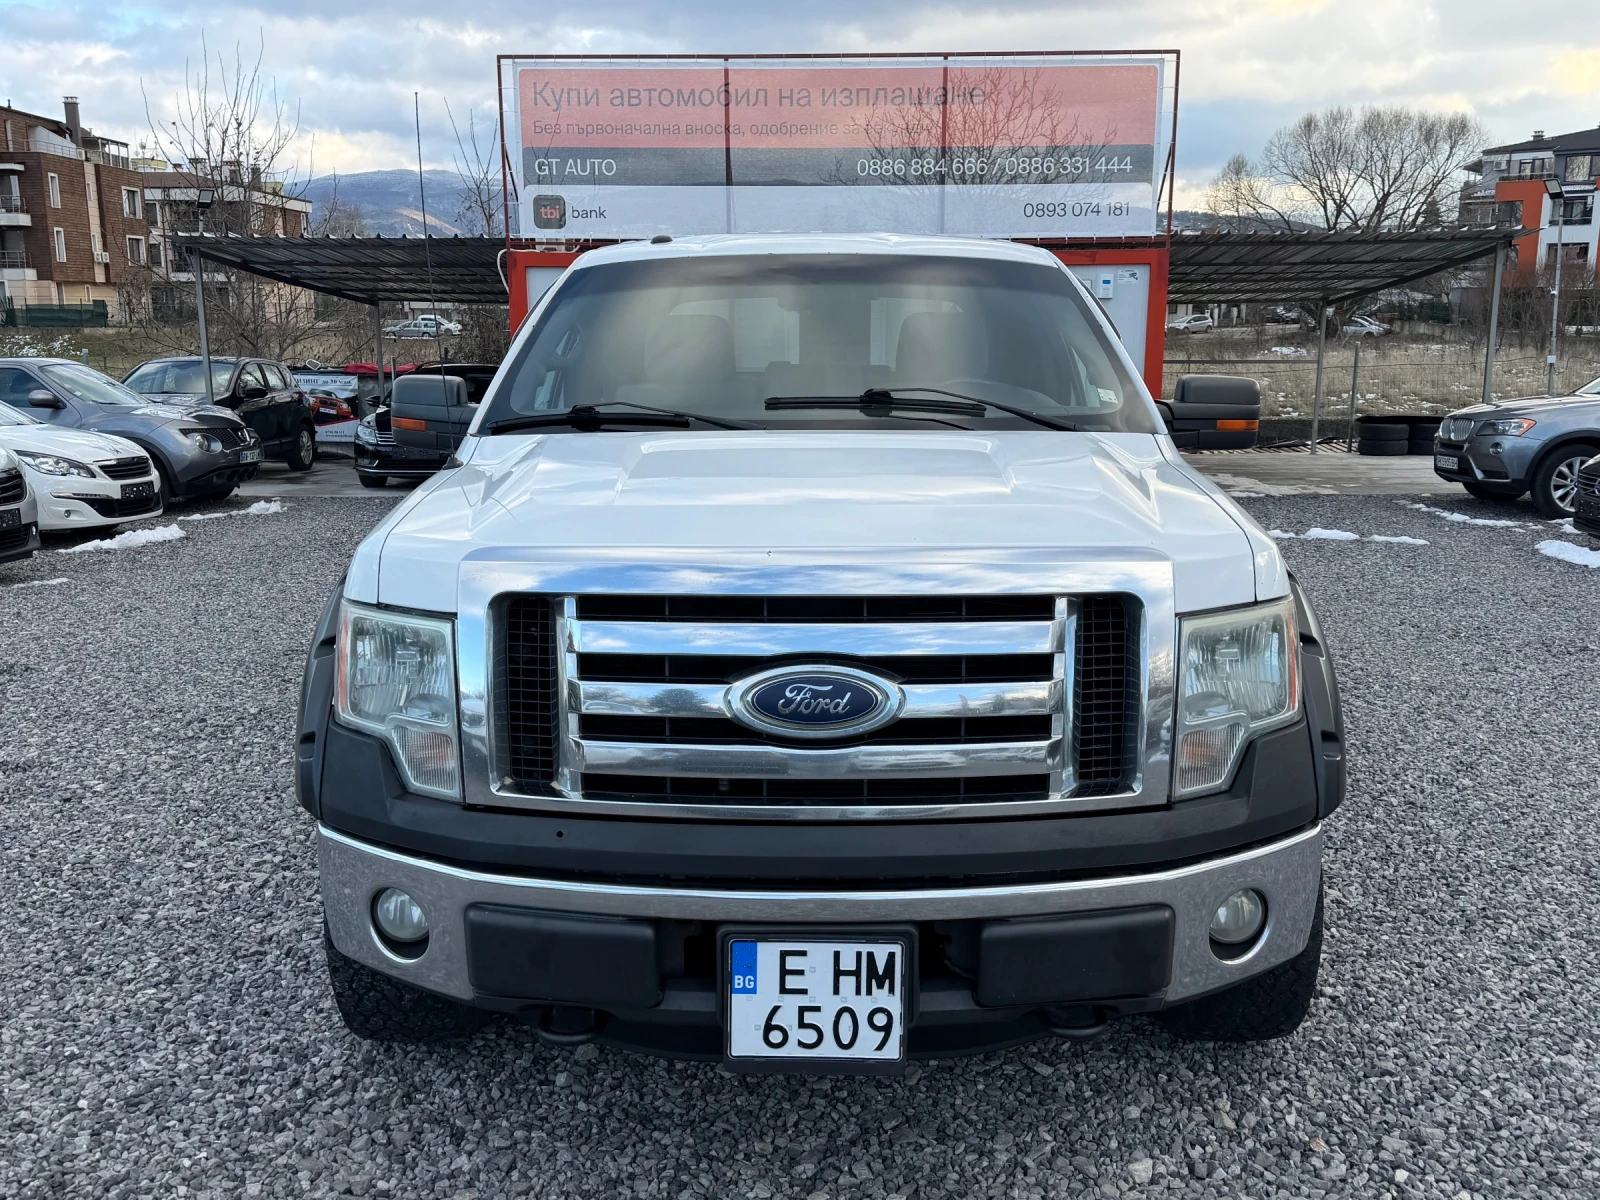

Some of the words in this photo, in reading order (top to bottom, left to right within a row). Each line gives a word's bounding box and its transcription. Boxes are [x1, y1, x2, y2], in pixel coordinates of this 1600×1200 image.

[533, 81, 600, 112] Купи
[610, 82, 769, 108] автомобил
[778, 87, 811, 107] на
[821, 85, 985, 110] изплащане
[533, 120, 562, 135] Без
[566, 122, 681, 138] първоначална
[685, 122, 745, 138] вноска,
[750, 120, 838, 138] одобрение
[843, 124, 859, 135] за
[534, 158, 560, 176] GT
[565, 158, 617, 176] AUTO
[857, 158, 906, 176] 0886
[910, 158, 948, 175] 884
[952, 157, 988, 175] 666
[992, 157, 1001, 175] /
[1005, 156, 1054, 174] 0886
[1059, 156, 1090, 173] 331
[1095, 155, 1133, 173] 444
[539, 205, 560, 220] tbi
[571, 205, 607, 220] bank
[1023, 202, 1067, 218] 0893
[1072, 202, 1102, 218] 074
[1105, 201, 1130, 217] 181
[777, 683, 852, 714] Ford
[734, 975, 755, 989] BG
[779, 949, 809, 995] E
[832, 950, 896, 996] HM
[762, 1005, 894, 1052] 6509
